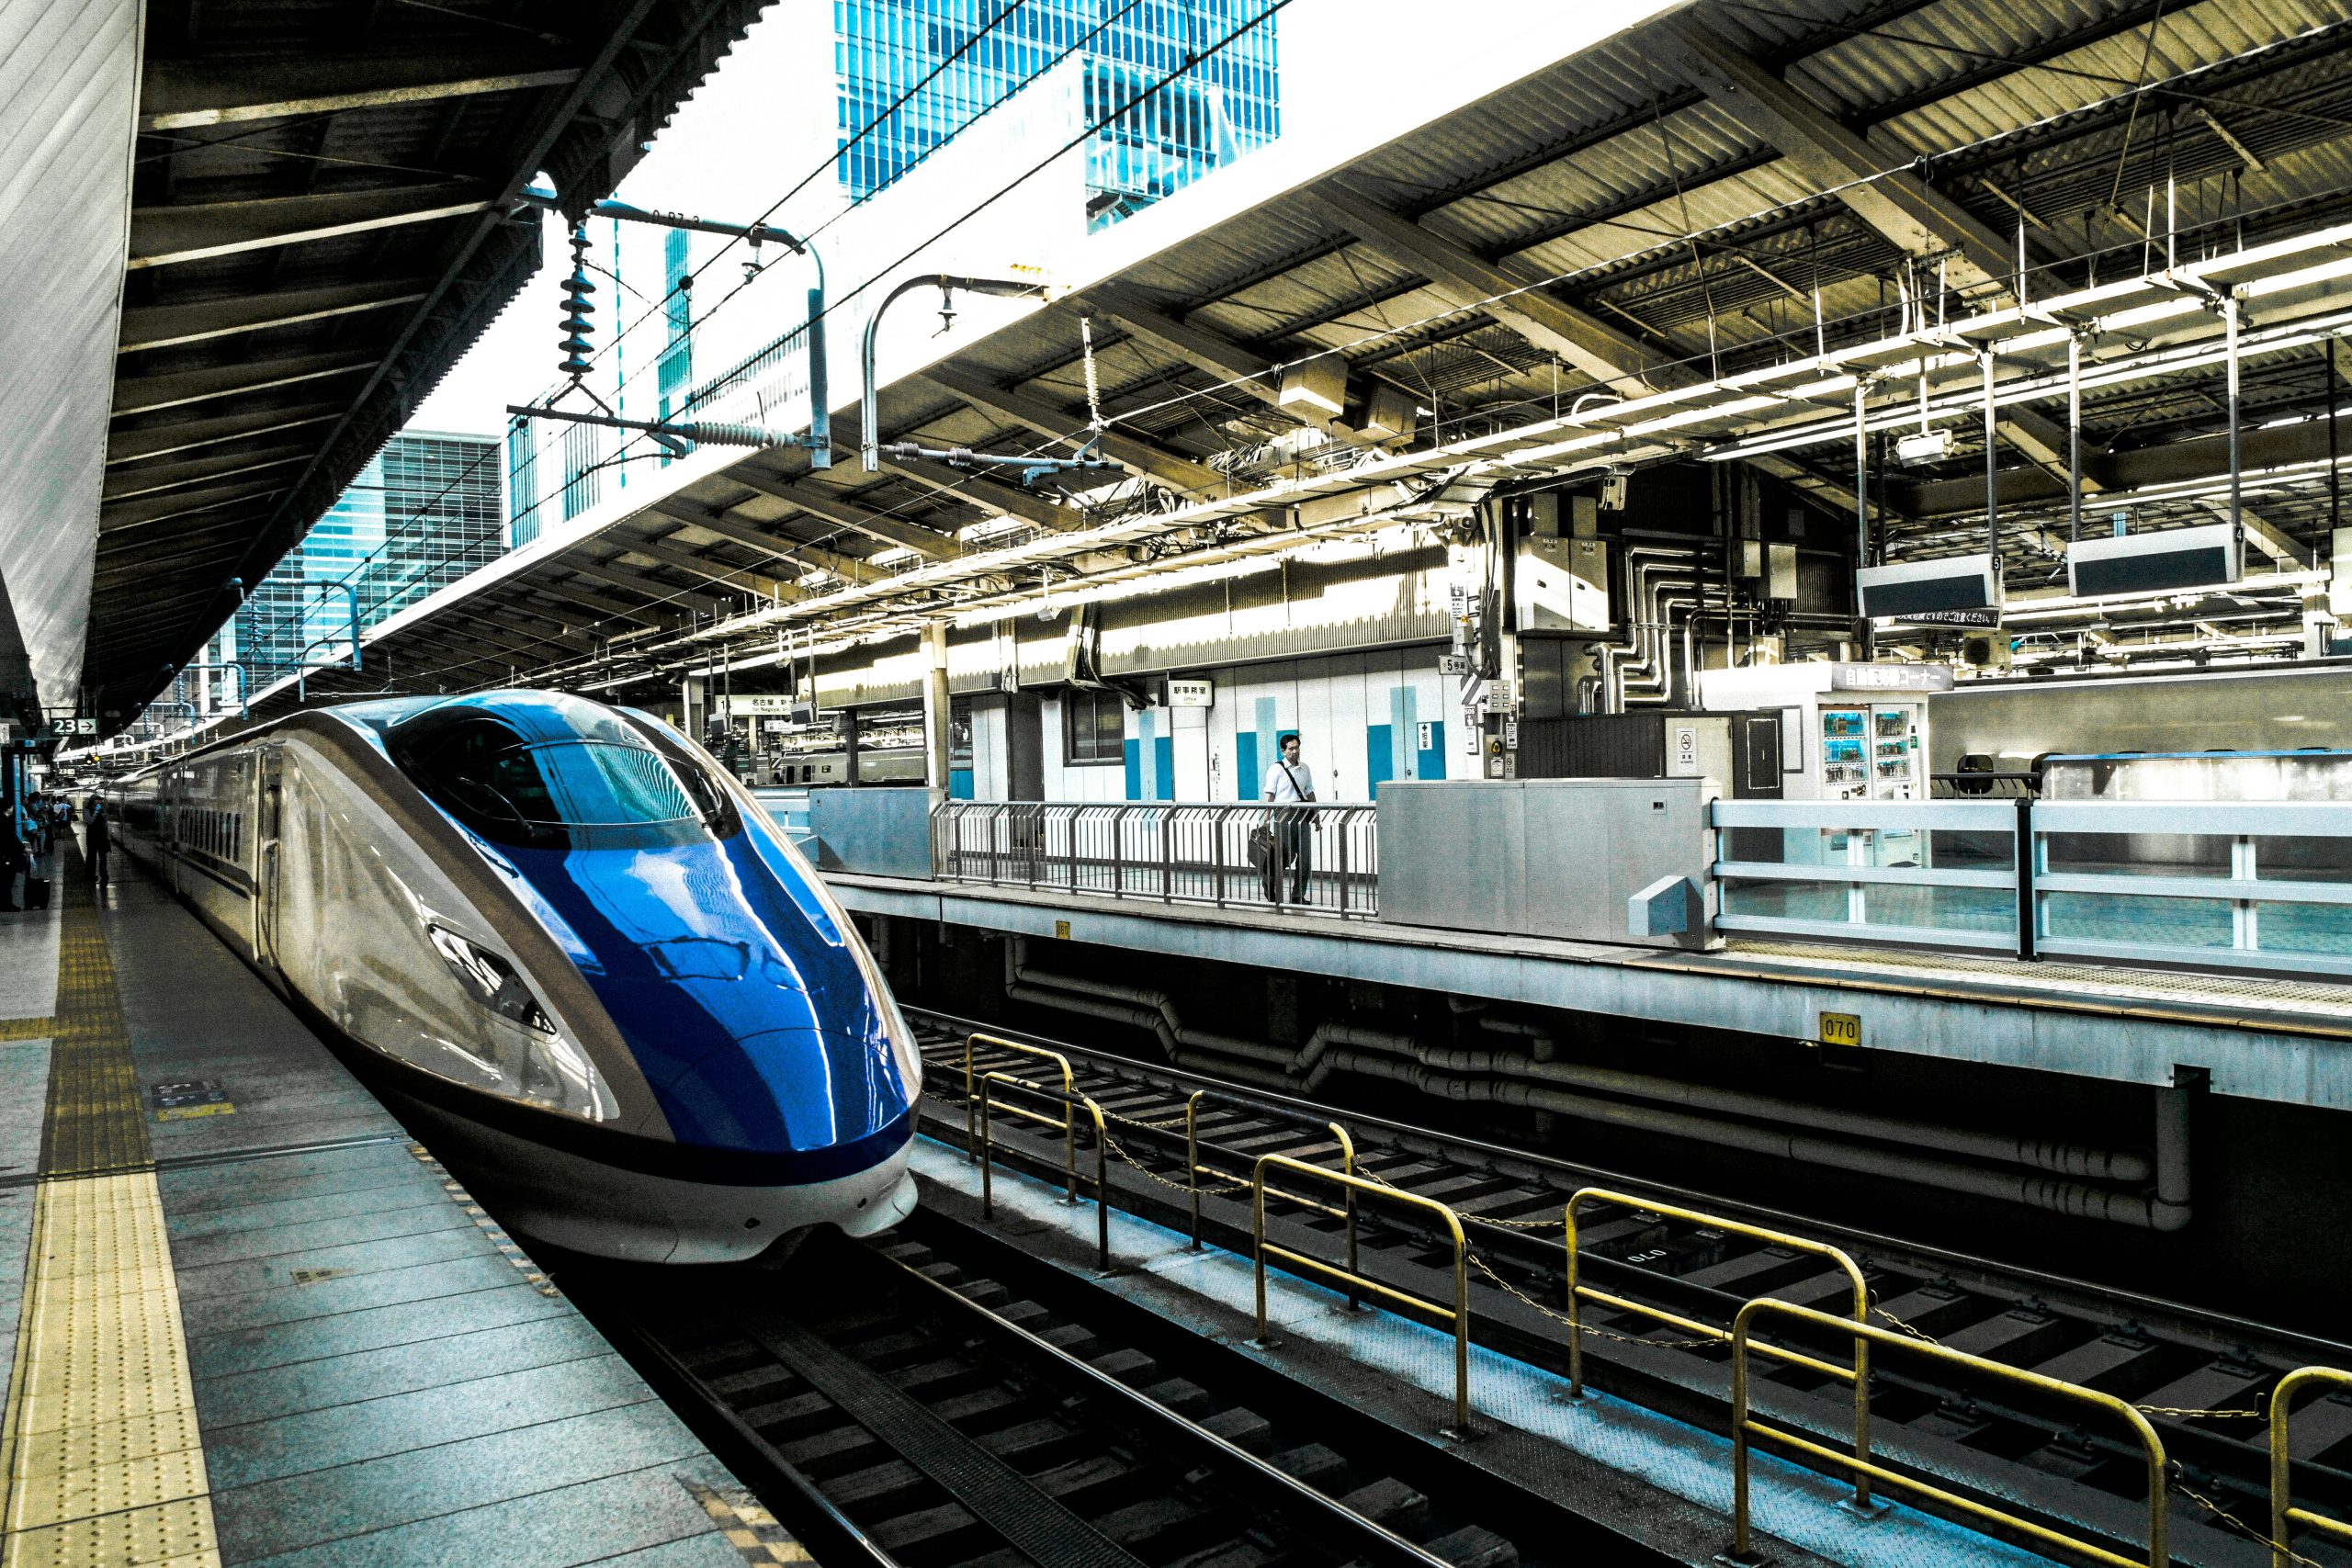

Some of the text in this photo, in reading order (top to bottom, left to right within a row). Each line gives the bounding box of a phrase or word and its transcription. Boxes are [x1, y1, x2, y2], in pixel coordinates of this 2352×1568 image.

[2236, 528, 2243, 542] 4
[1993, 558, 2000, 570] 5
[1173, 686, 1206, 694] 駅事務室
[54, 719, 76, 733] 23
[1826, 1019, 1855, 1038] 070
